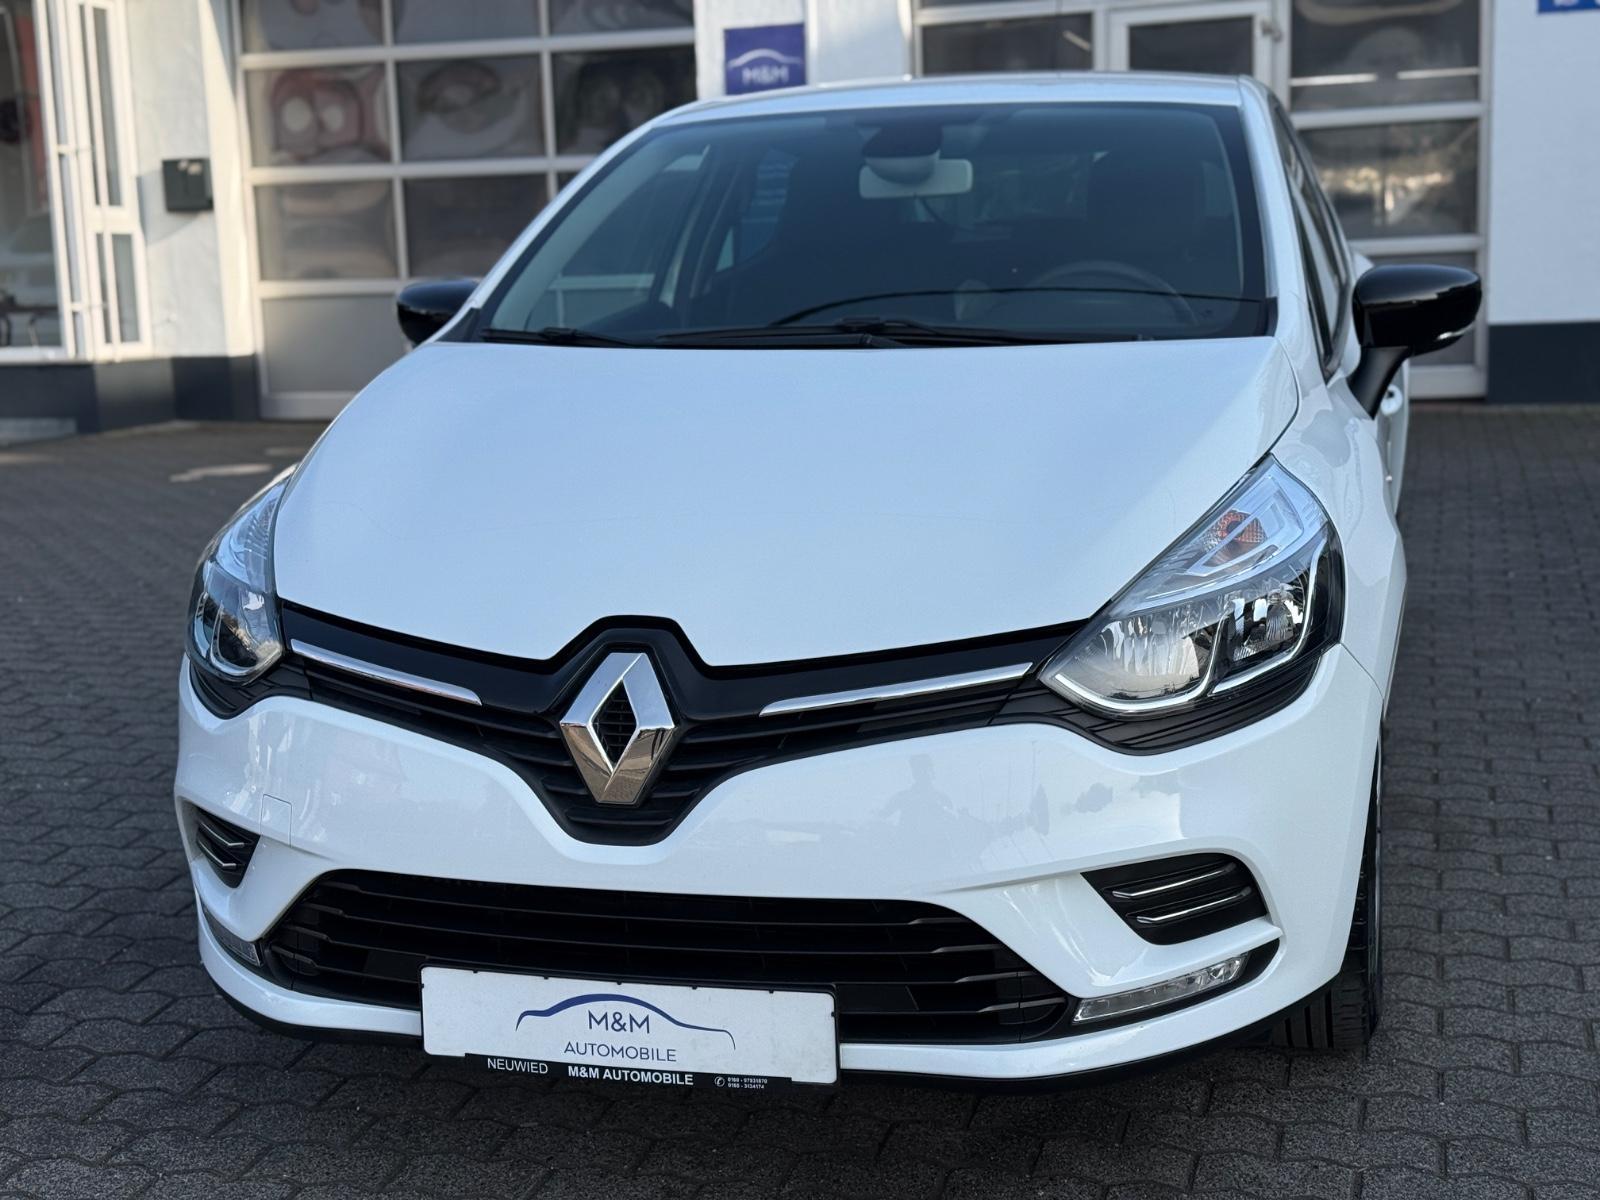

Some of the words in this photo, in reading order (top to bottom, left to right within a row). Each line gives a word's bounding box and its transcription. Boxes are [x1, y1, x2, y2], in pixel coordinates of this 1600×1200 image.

[587, 1010, 650, 1034] M&M
[564, 1041, 677, 1062] AUTOMOBILE
[487, 1057, 549, 1074] NEUWIED
[567, 1065, 600, 1079] M&M
[602, 1068, 694, 1086] AUTOMOBILE
